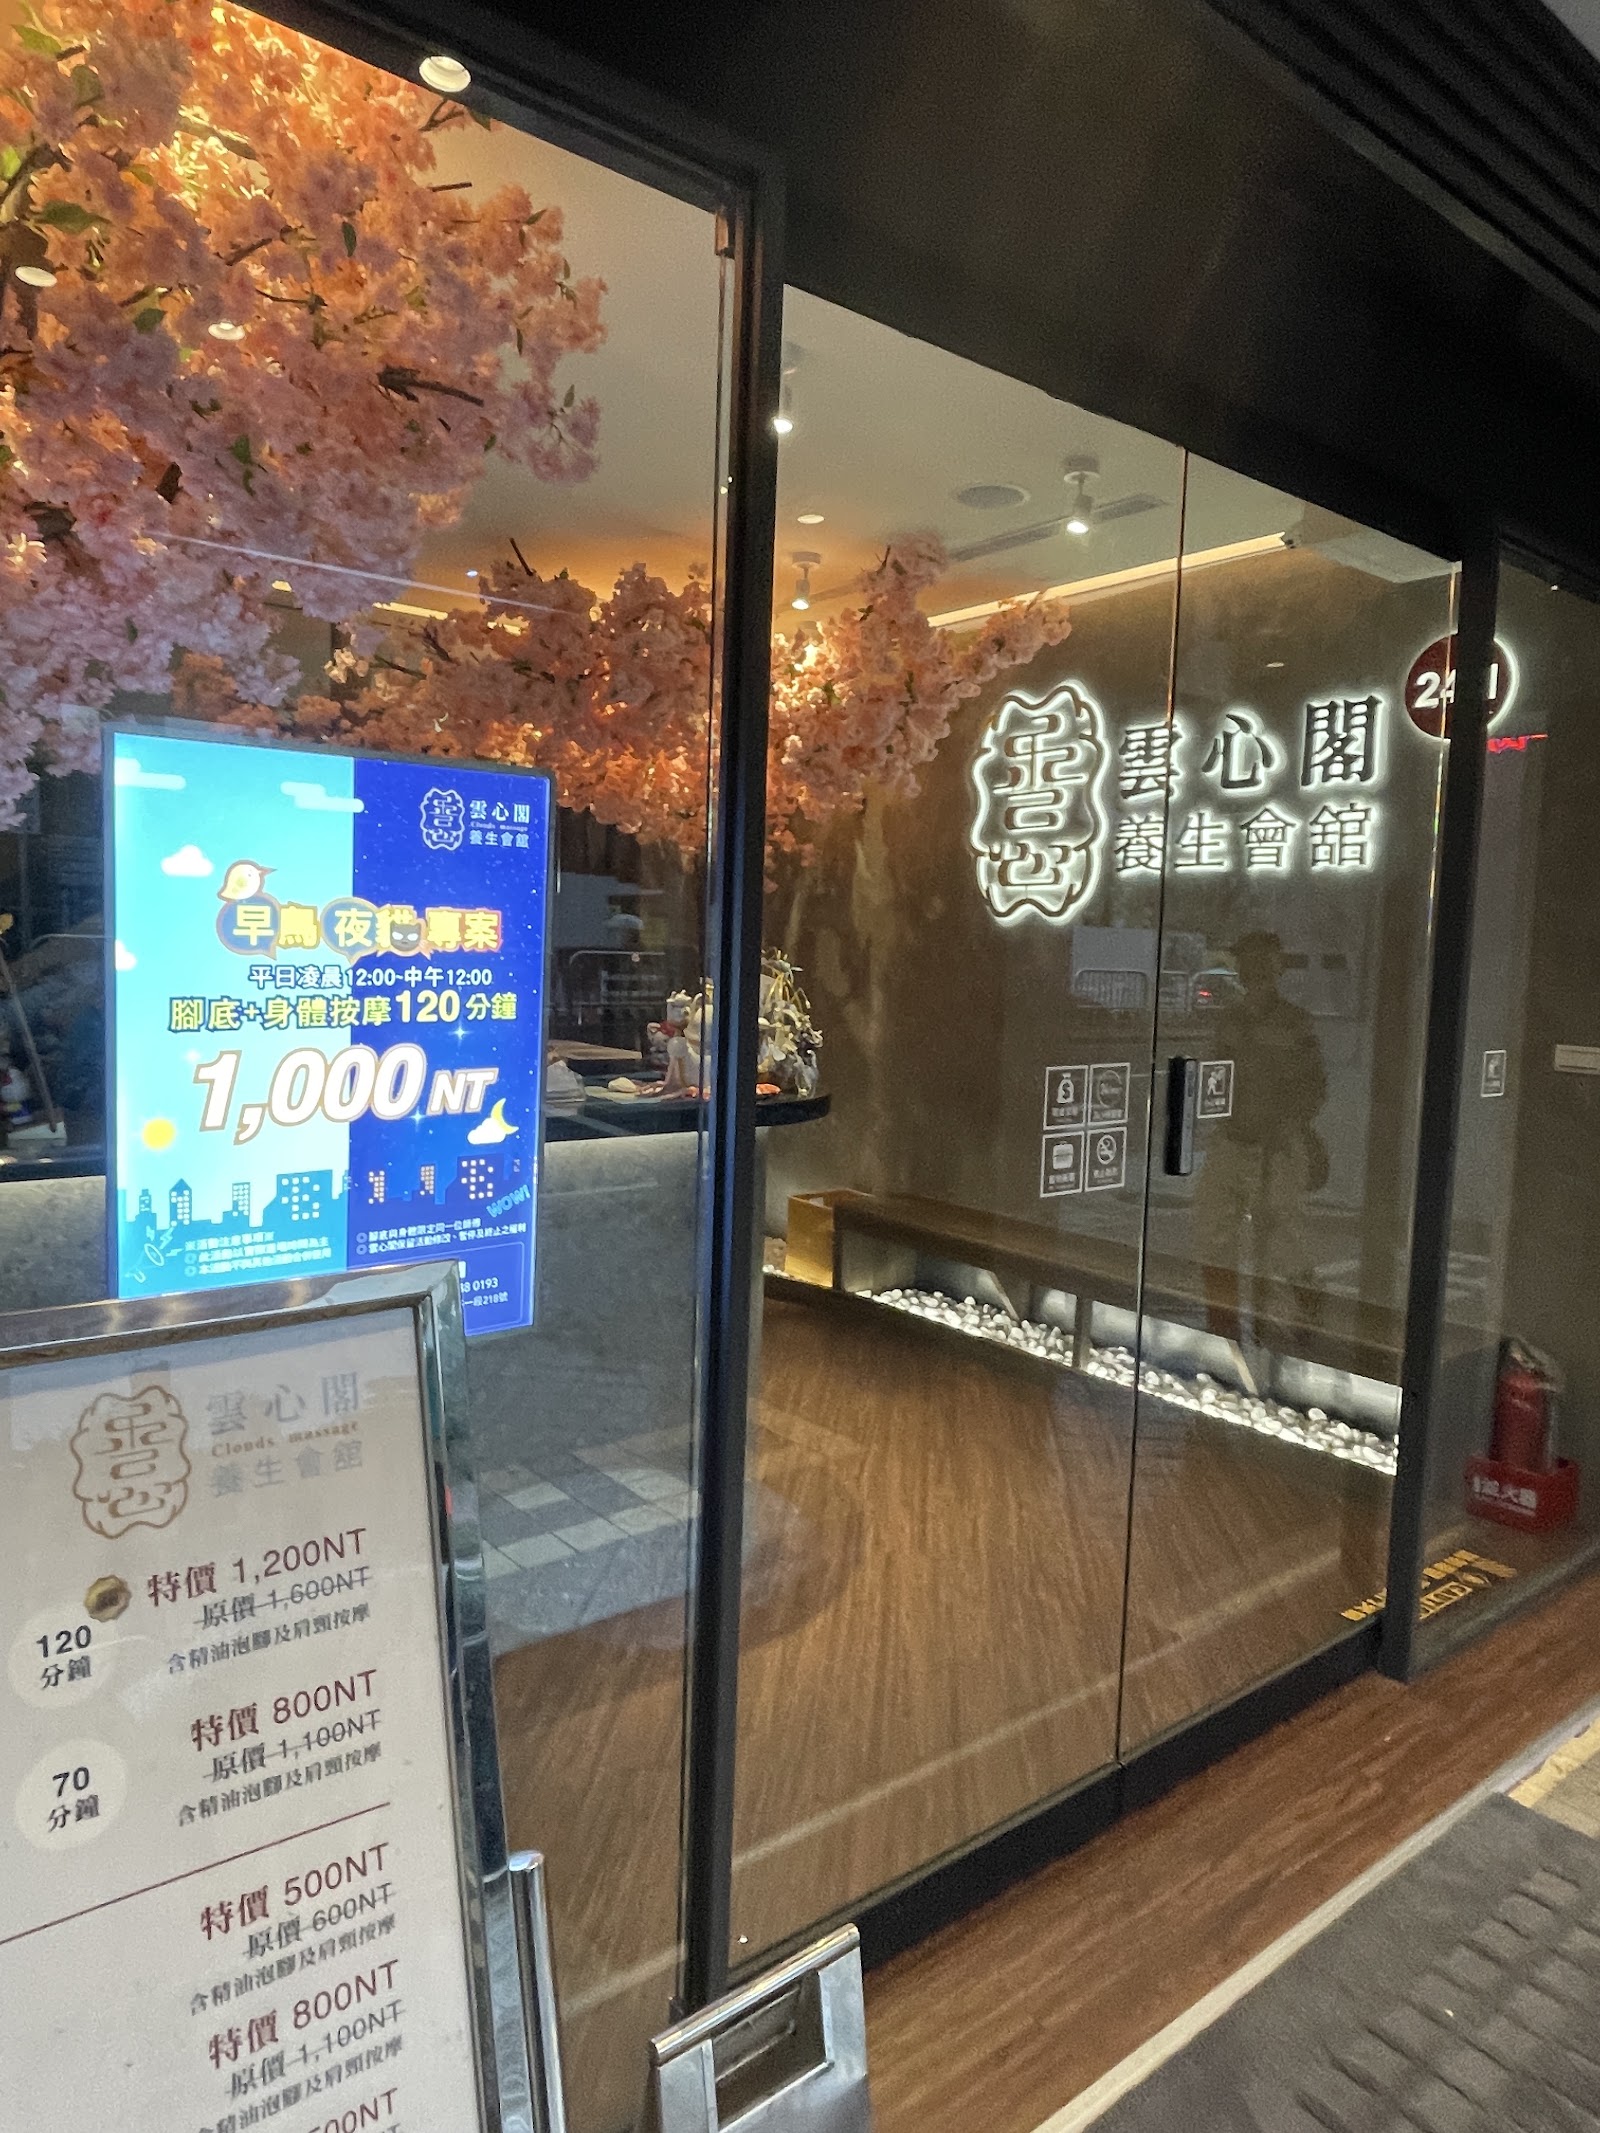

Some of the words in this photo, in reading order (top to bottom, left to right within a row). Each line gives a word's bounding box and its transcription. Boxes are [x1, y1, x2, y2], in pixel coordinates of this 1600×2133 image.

[1118, 695, 1383, 800] 雲心閣
[469, 800, 530, 824] 雲心閣
[486, 1184, 532, 1218] WOW!
[206, 1371, 359, 1436] 雲心閣
[147, 1561, 217, 1608] 特價
[200, 1592, 257, 1631] 原價
[36, 1625, 92, 1658] 120
[40, 1655, 93, 1690] 分鐘
[190, 1702, 260, 1753] 特價
[272, 1668, 378, 1725] 800NT
[52, 1766, 90, 1798] 70
[210, 1741, 267, 1783] 原價
[47, 1794, 101, 1834] 分鐘
[200, 1884, 270, 1941] 特價
[283, 1841, 389, 1907] 500NT
[246, 1915, 302, 1960] 原價
[312, 1881, 394, 1932] 600NT
[208, 2008, 279, 2070] 特價
[292, 1958, 399, 2030] 800NT
